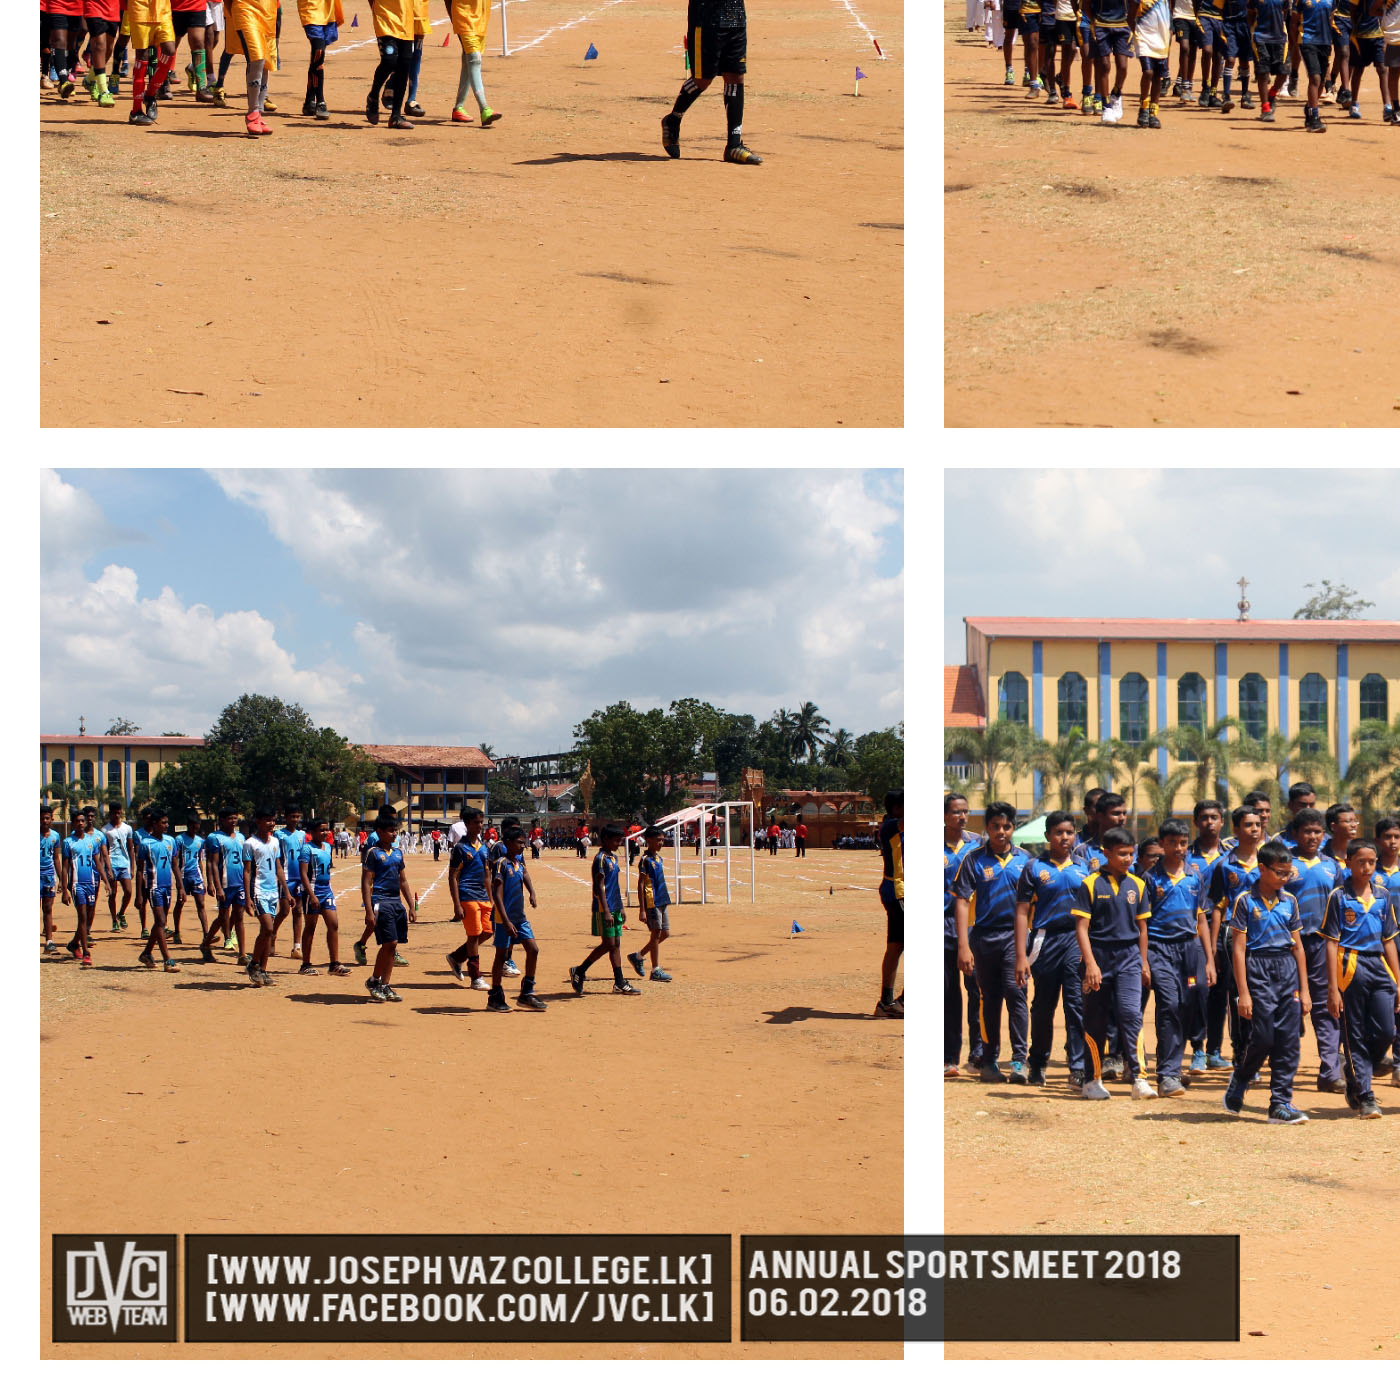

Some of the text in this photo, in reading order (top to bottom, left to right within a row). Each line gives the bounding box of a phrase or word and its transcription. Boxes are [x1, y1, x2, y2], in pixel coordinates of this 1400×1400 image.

[79, 854, 92, 867] 15
[160, 856, 168, 869] 7
[231, 851, 241, 865] 3
[266, 857, 273, 871] 1
